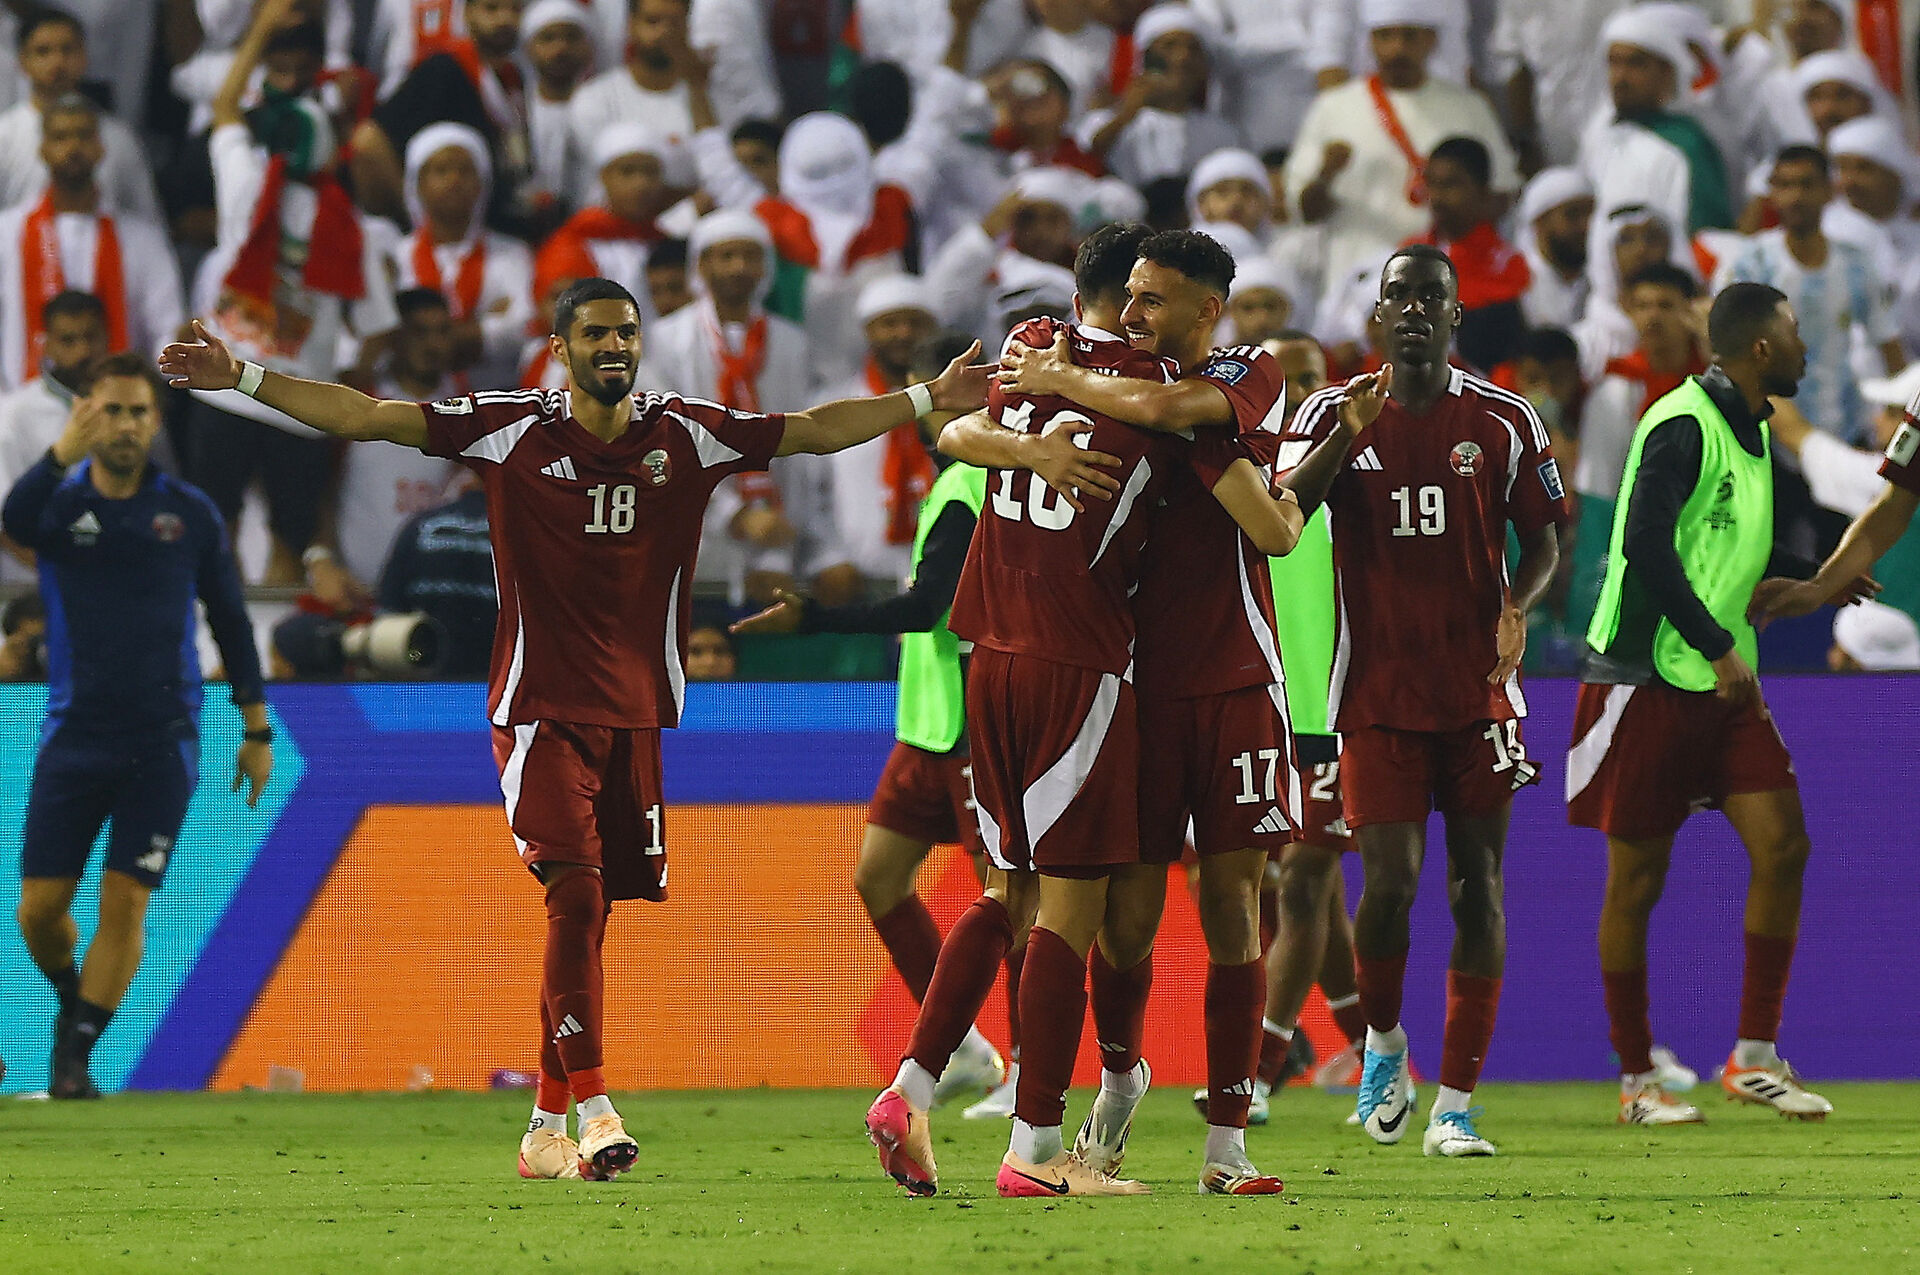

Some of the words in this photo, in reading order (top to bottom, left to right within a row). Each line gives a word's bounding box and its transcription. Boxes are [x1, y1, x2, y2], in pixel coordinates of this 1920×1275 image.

[585, 484, 636, 533] 18
[1391, 485, 1446, 536] 19
[1233, 749, 1279, 804] 17
